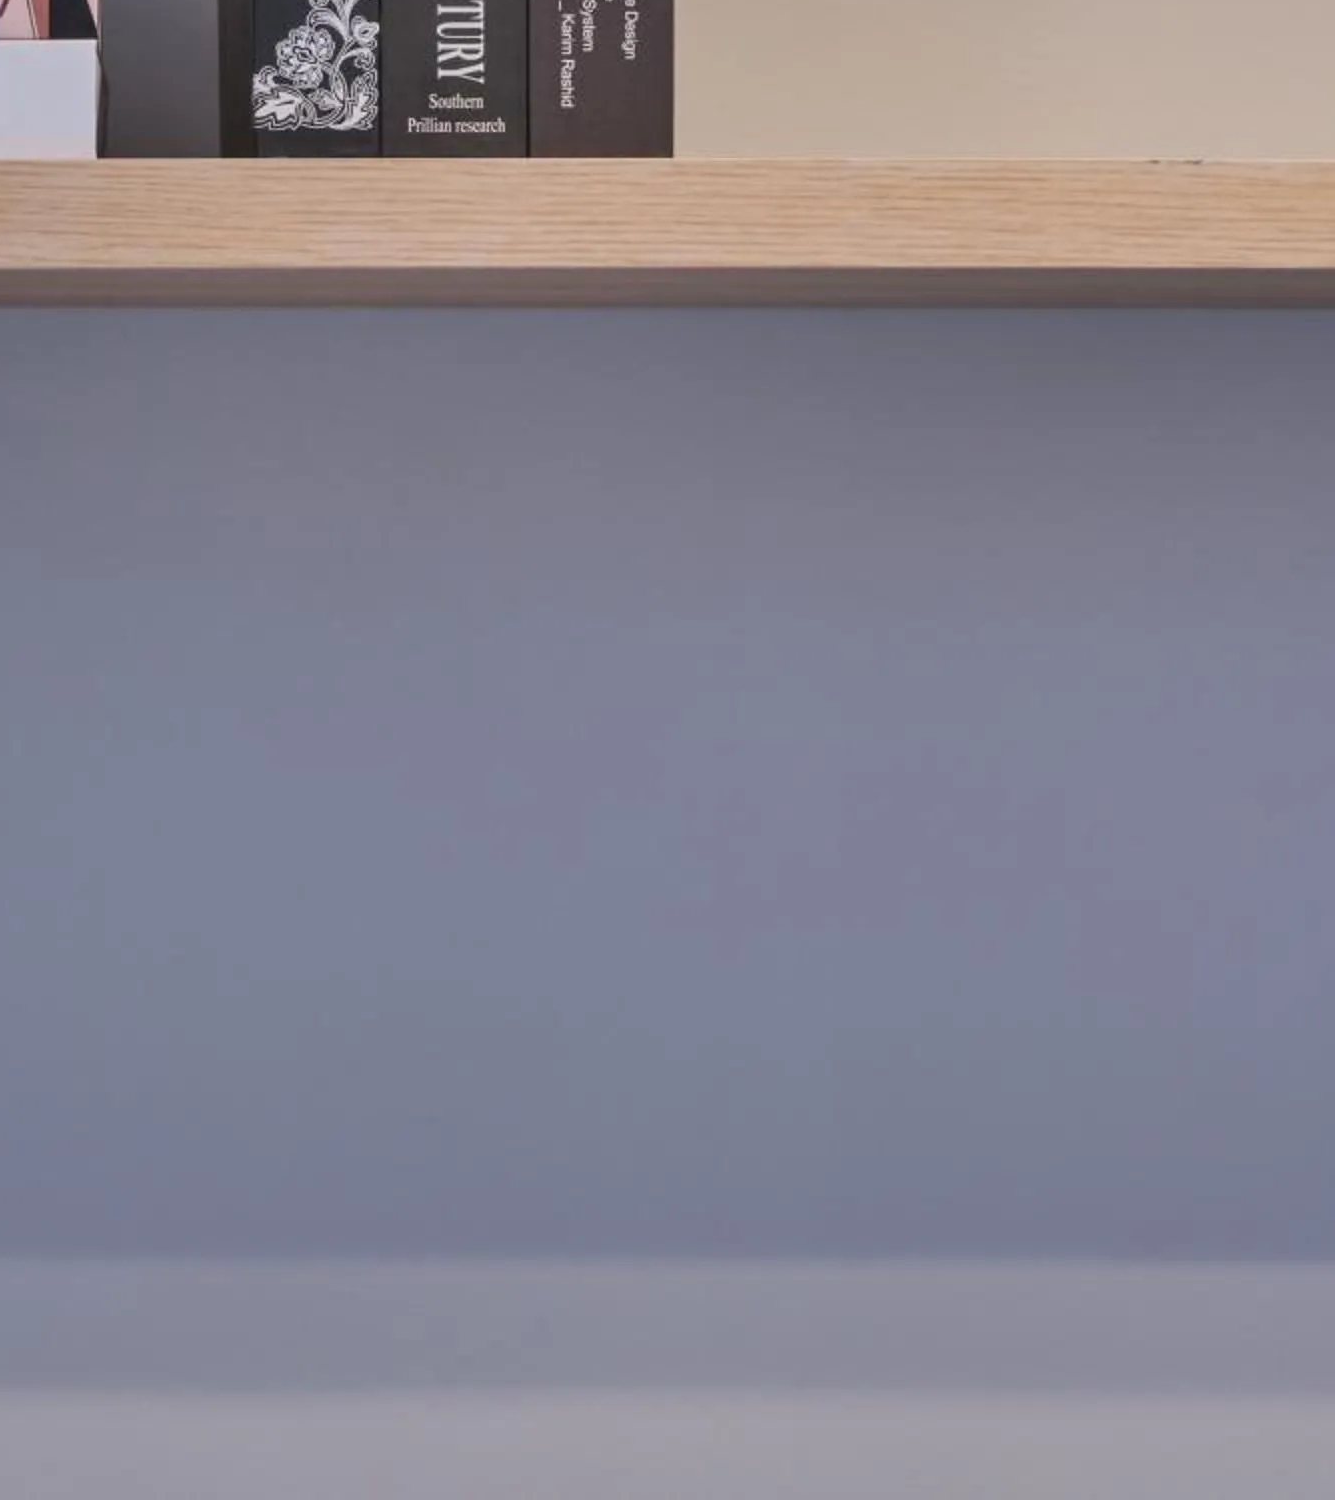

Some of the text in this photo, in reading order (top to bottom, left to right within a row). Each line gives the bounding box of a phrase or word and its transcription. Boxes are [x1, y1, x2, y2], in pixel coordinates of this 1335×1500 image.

[561, 14, 575, 54] Karim
[580, 0, 597, 52] System
[621, 11, 639, 59] Design
[429, 93, 483, 109] Southern
[561, 59, 575, 107] Rashid
[455, 117, 505, 132] research
